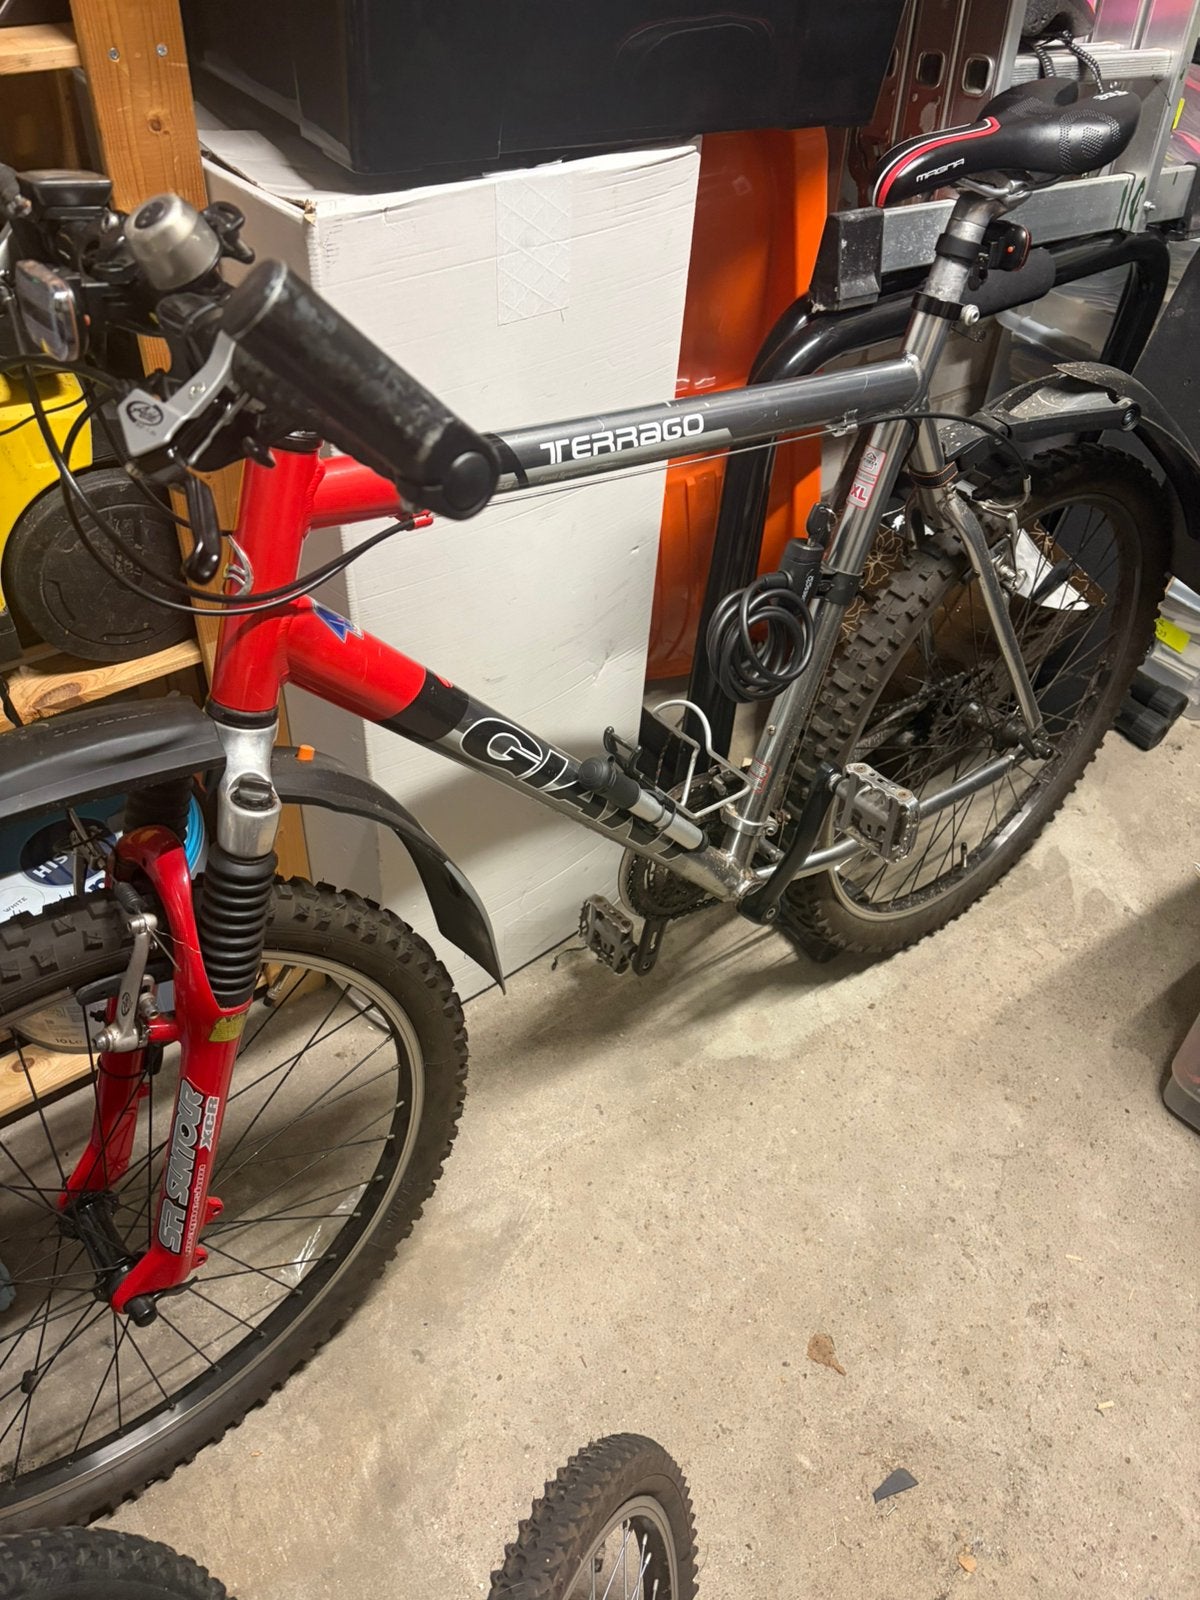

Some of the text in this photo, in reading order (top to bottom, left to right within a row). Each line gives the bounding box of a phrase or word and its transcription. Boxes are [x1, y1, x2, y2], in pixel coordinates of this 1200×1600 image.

[850, 483, 867, 501] XL
[3, 896, 28, 913] WHITE
[165, 1079, 204, 1206] SUNTOUR
[200, 1096, 220, 1152] XCR
[158, 1198, 187, 1253] SR
